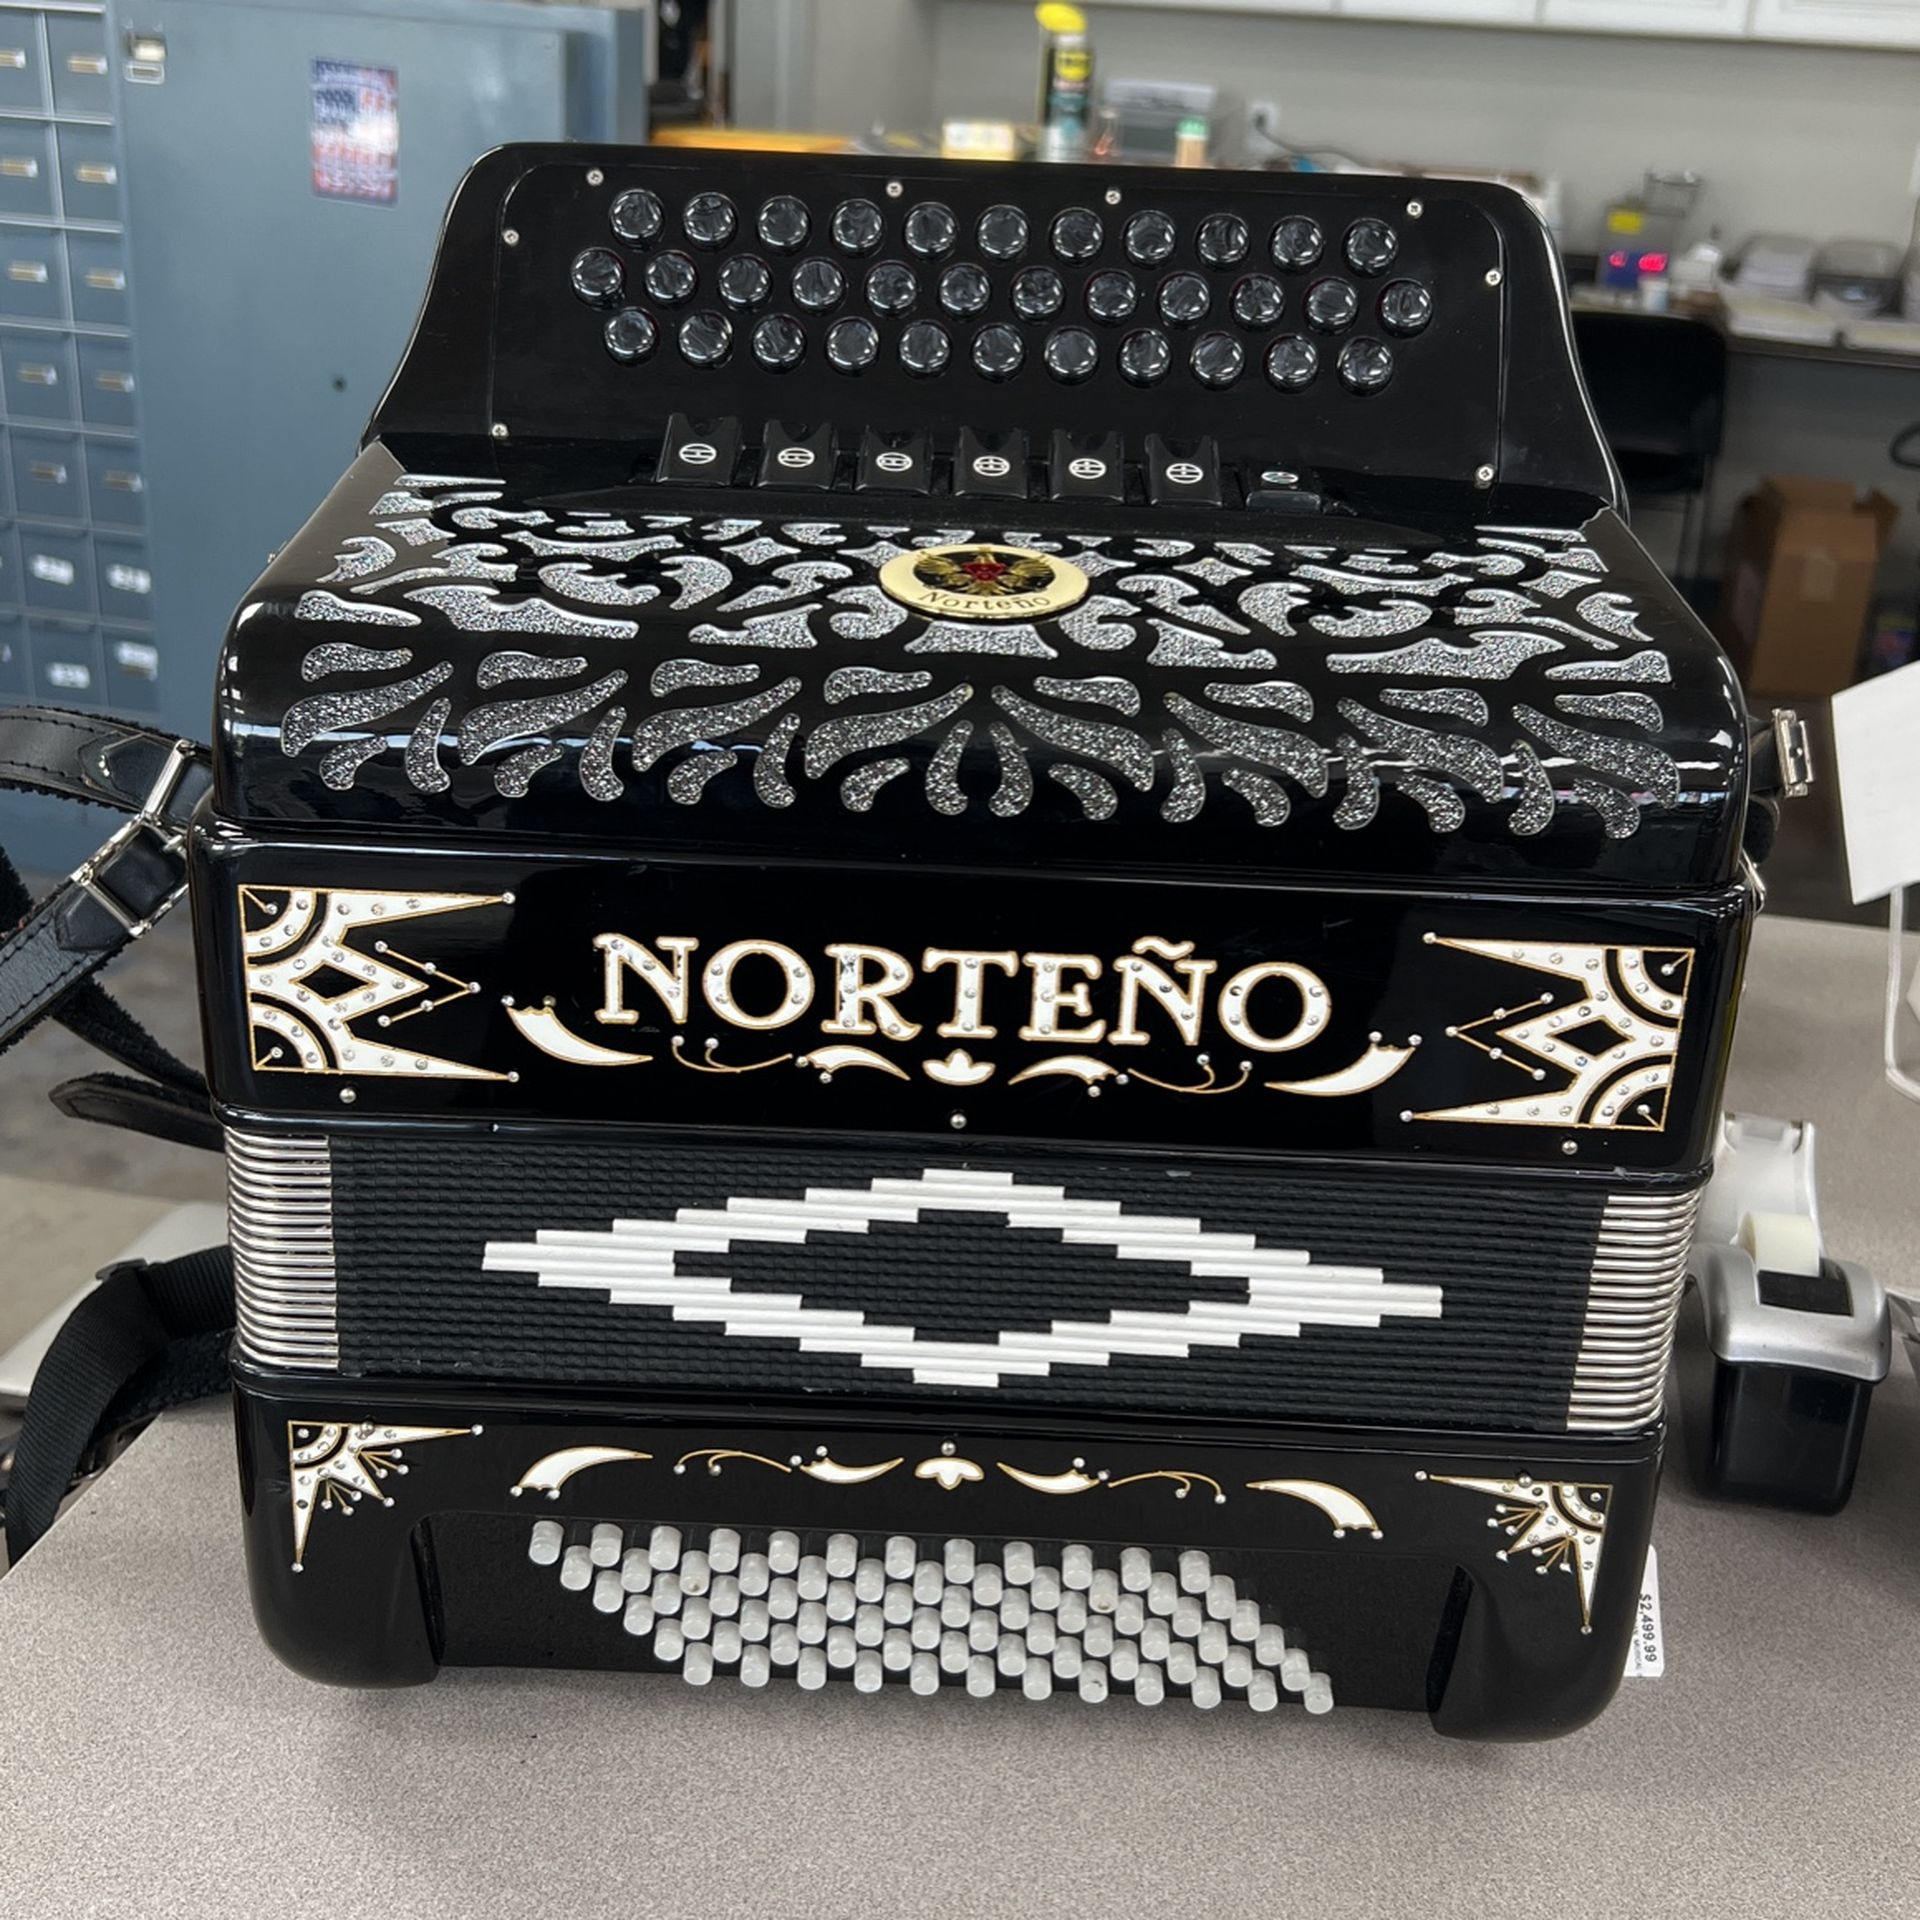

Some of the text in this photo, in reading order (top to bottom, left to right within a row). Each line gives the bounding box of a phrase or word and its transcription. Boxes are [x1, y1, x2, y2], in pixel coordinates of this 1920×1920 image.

[918, 592, 1051, 611] Norteño
[593, 932, 1332, 1052] NORTEÑO
[1638, 1593, 1658, 1662] $2,499.99
